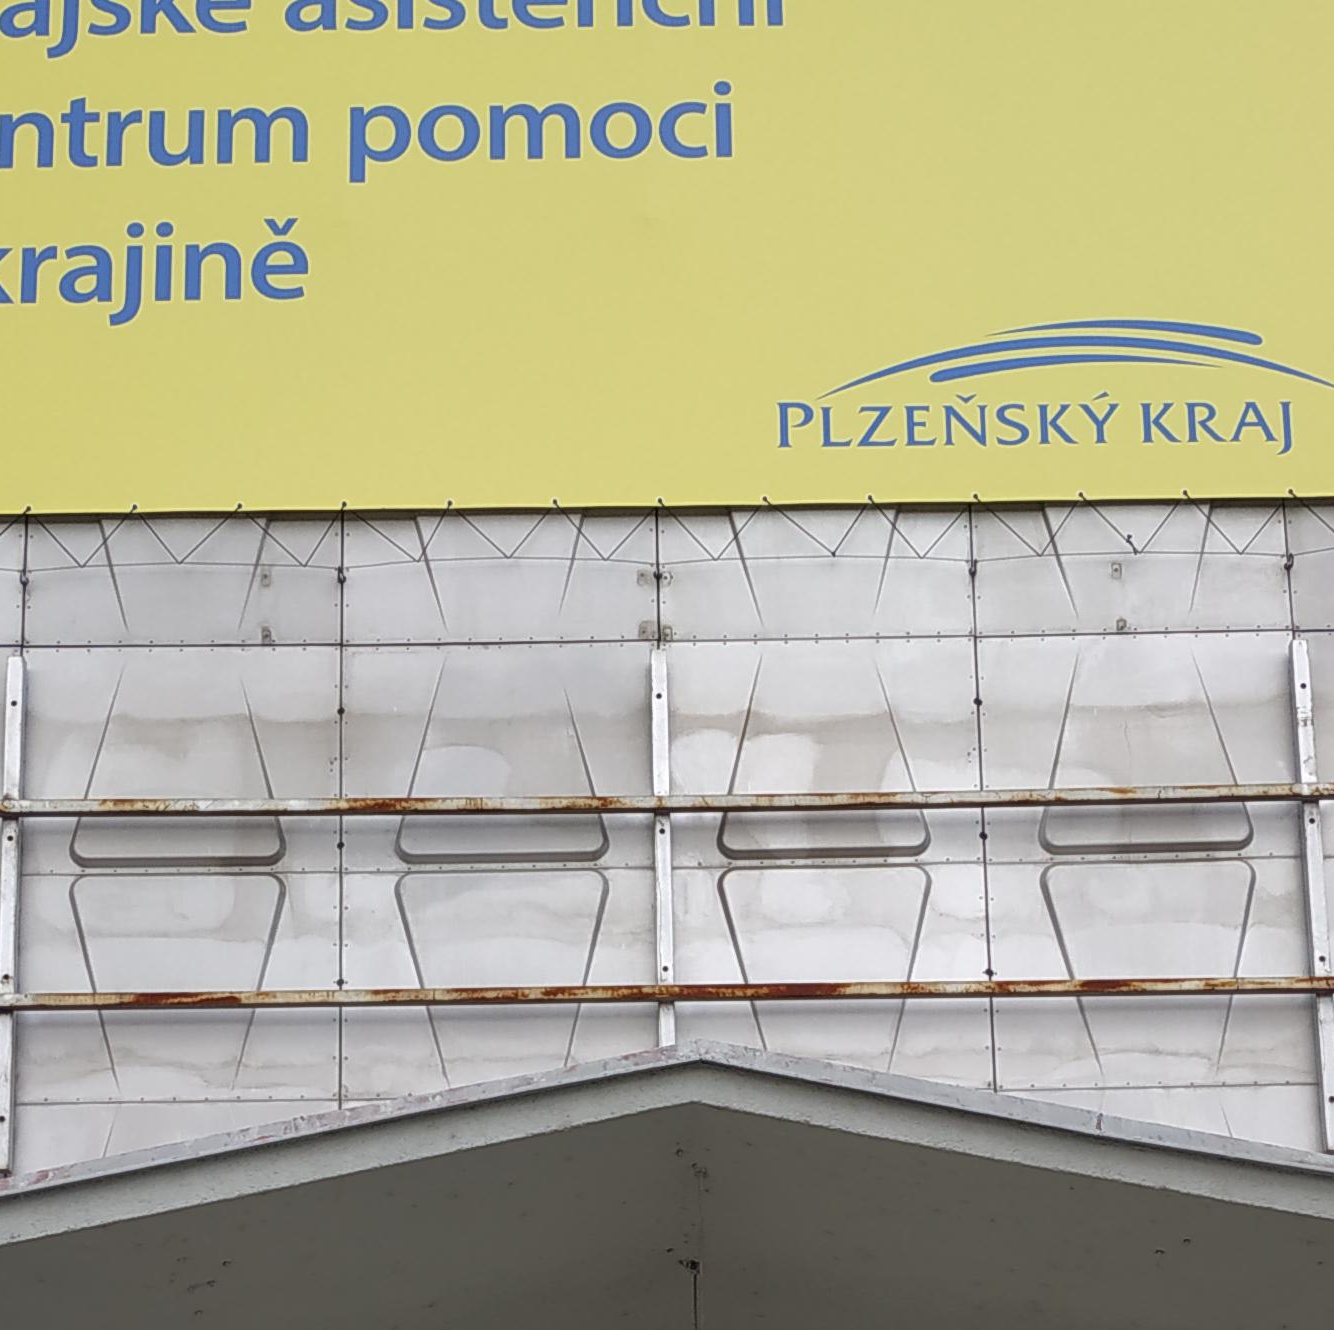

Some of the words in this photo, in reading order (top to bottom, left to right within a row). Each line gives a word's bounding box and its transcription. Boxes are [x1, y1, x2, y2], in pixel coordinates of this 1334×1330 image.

[349, 80, 734, 184] pomoci
[776, 391, 1120, 449] PLZEŇSKÝ
[1140, 400, 1294, 456] KRAJ
